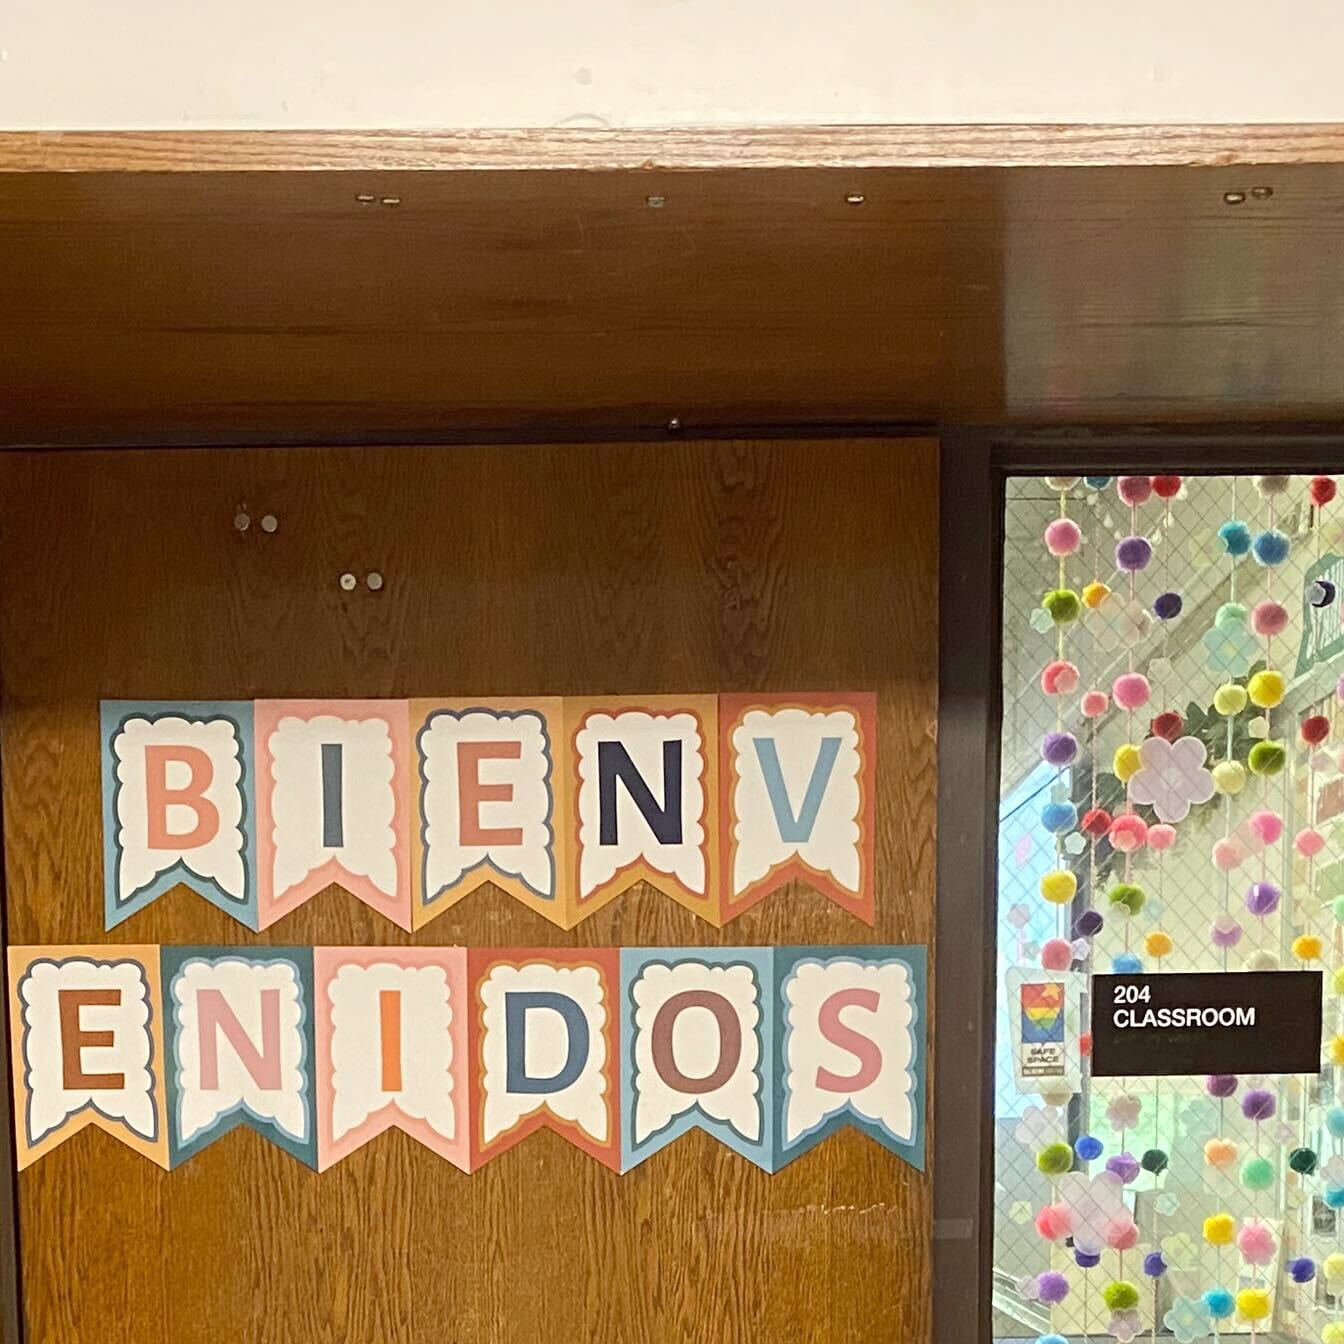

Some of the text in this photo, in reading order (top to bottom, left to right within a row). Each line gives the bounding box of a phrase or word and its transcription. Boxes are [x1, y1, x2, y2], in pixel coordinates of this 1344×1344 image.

[143, 736, 843, 851] BIENV
[1113, 984, 1152, 1004] 204
[1113, 1006, 1256, 1029] CLASSROOM
[58, 987, 884, 1095] ENIDOS
[1030, 1047, 1056, 1056] SAFE
[1026, 1055, 1059, 1065] SPACE
